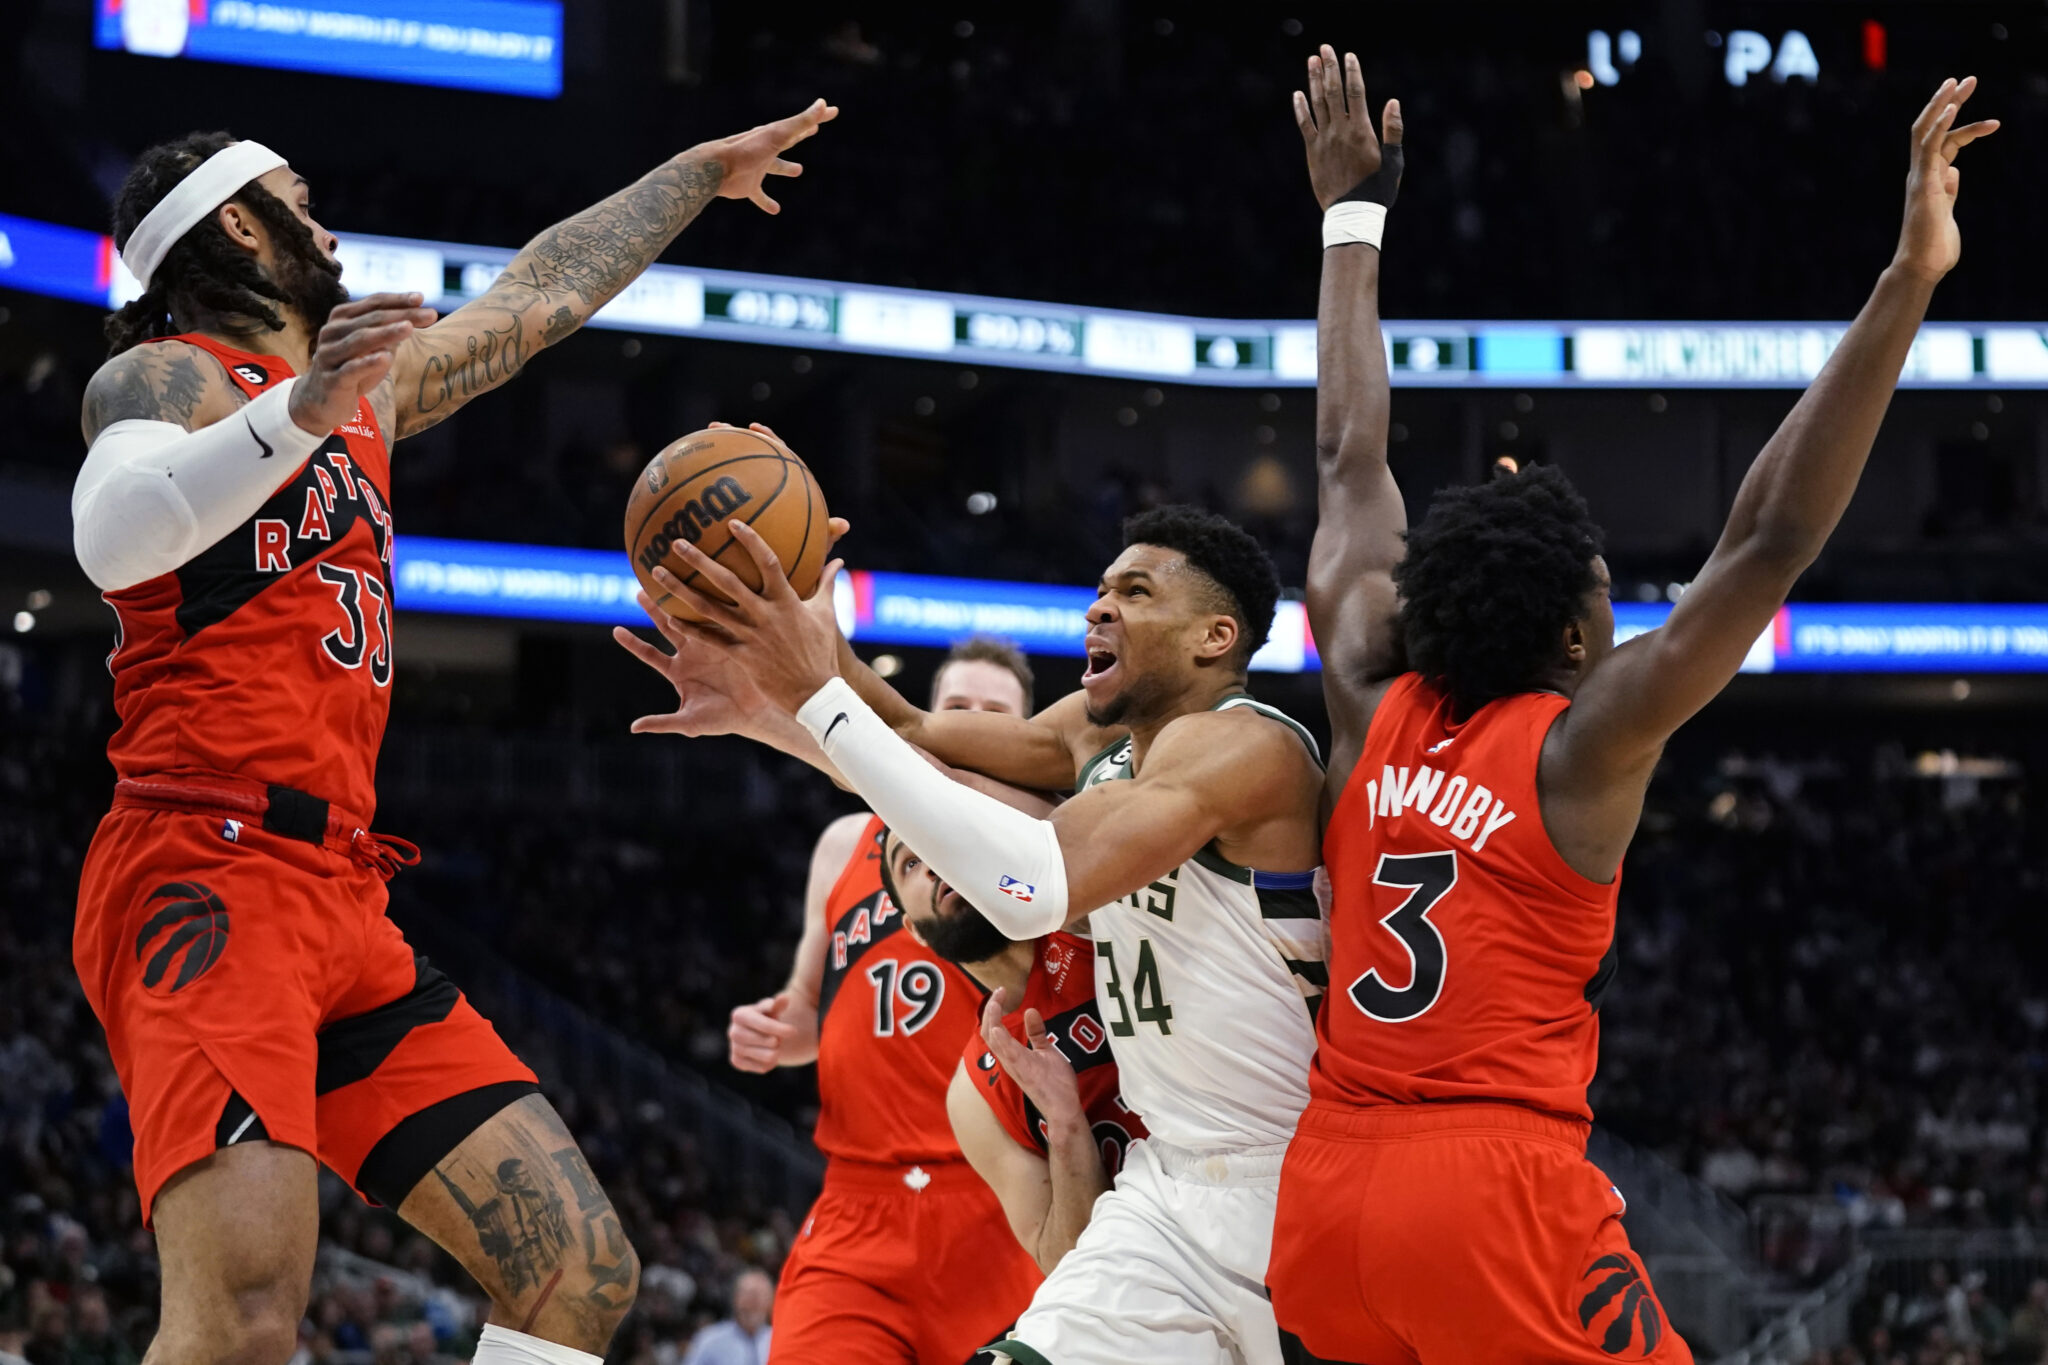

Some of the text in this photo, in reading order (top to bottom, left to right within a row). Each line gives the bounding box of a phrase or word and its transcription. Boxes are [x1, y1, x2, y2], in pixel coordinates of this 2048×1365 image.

[417, 313, 530, 414] Child
[358, 425, 375, 439] Life
[638, 475, 753, 575] Wilson
[316, 561, 392, 687] 33
[1054, 948, 1076, 994] Sun Life
[1347, 850, 1457, 1023] 3
[865, 958, 946, 1038] 19
[1095, 937, 1174, 1038] 34
